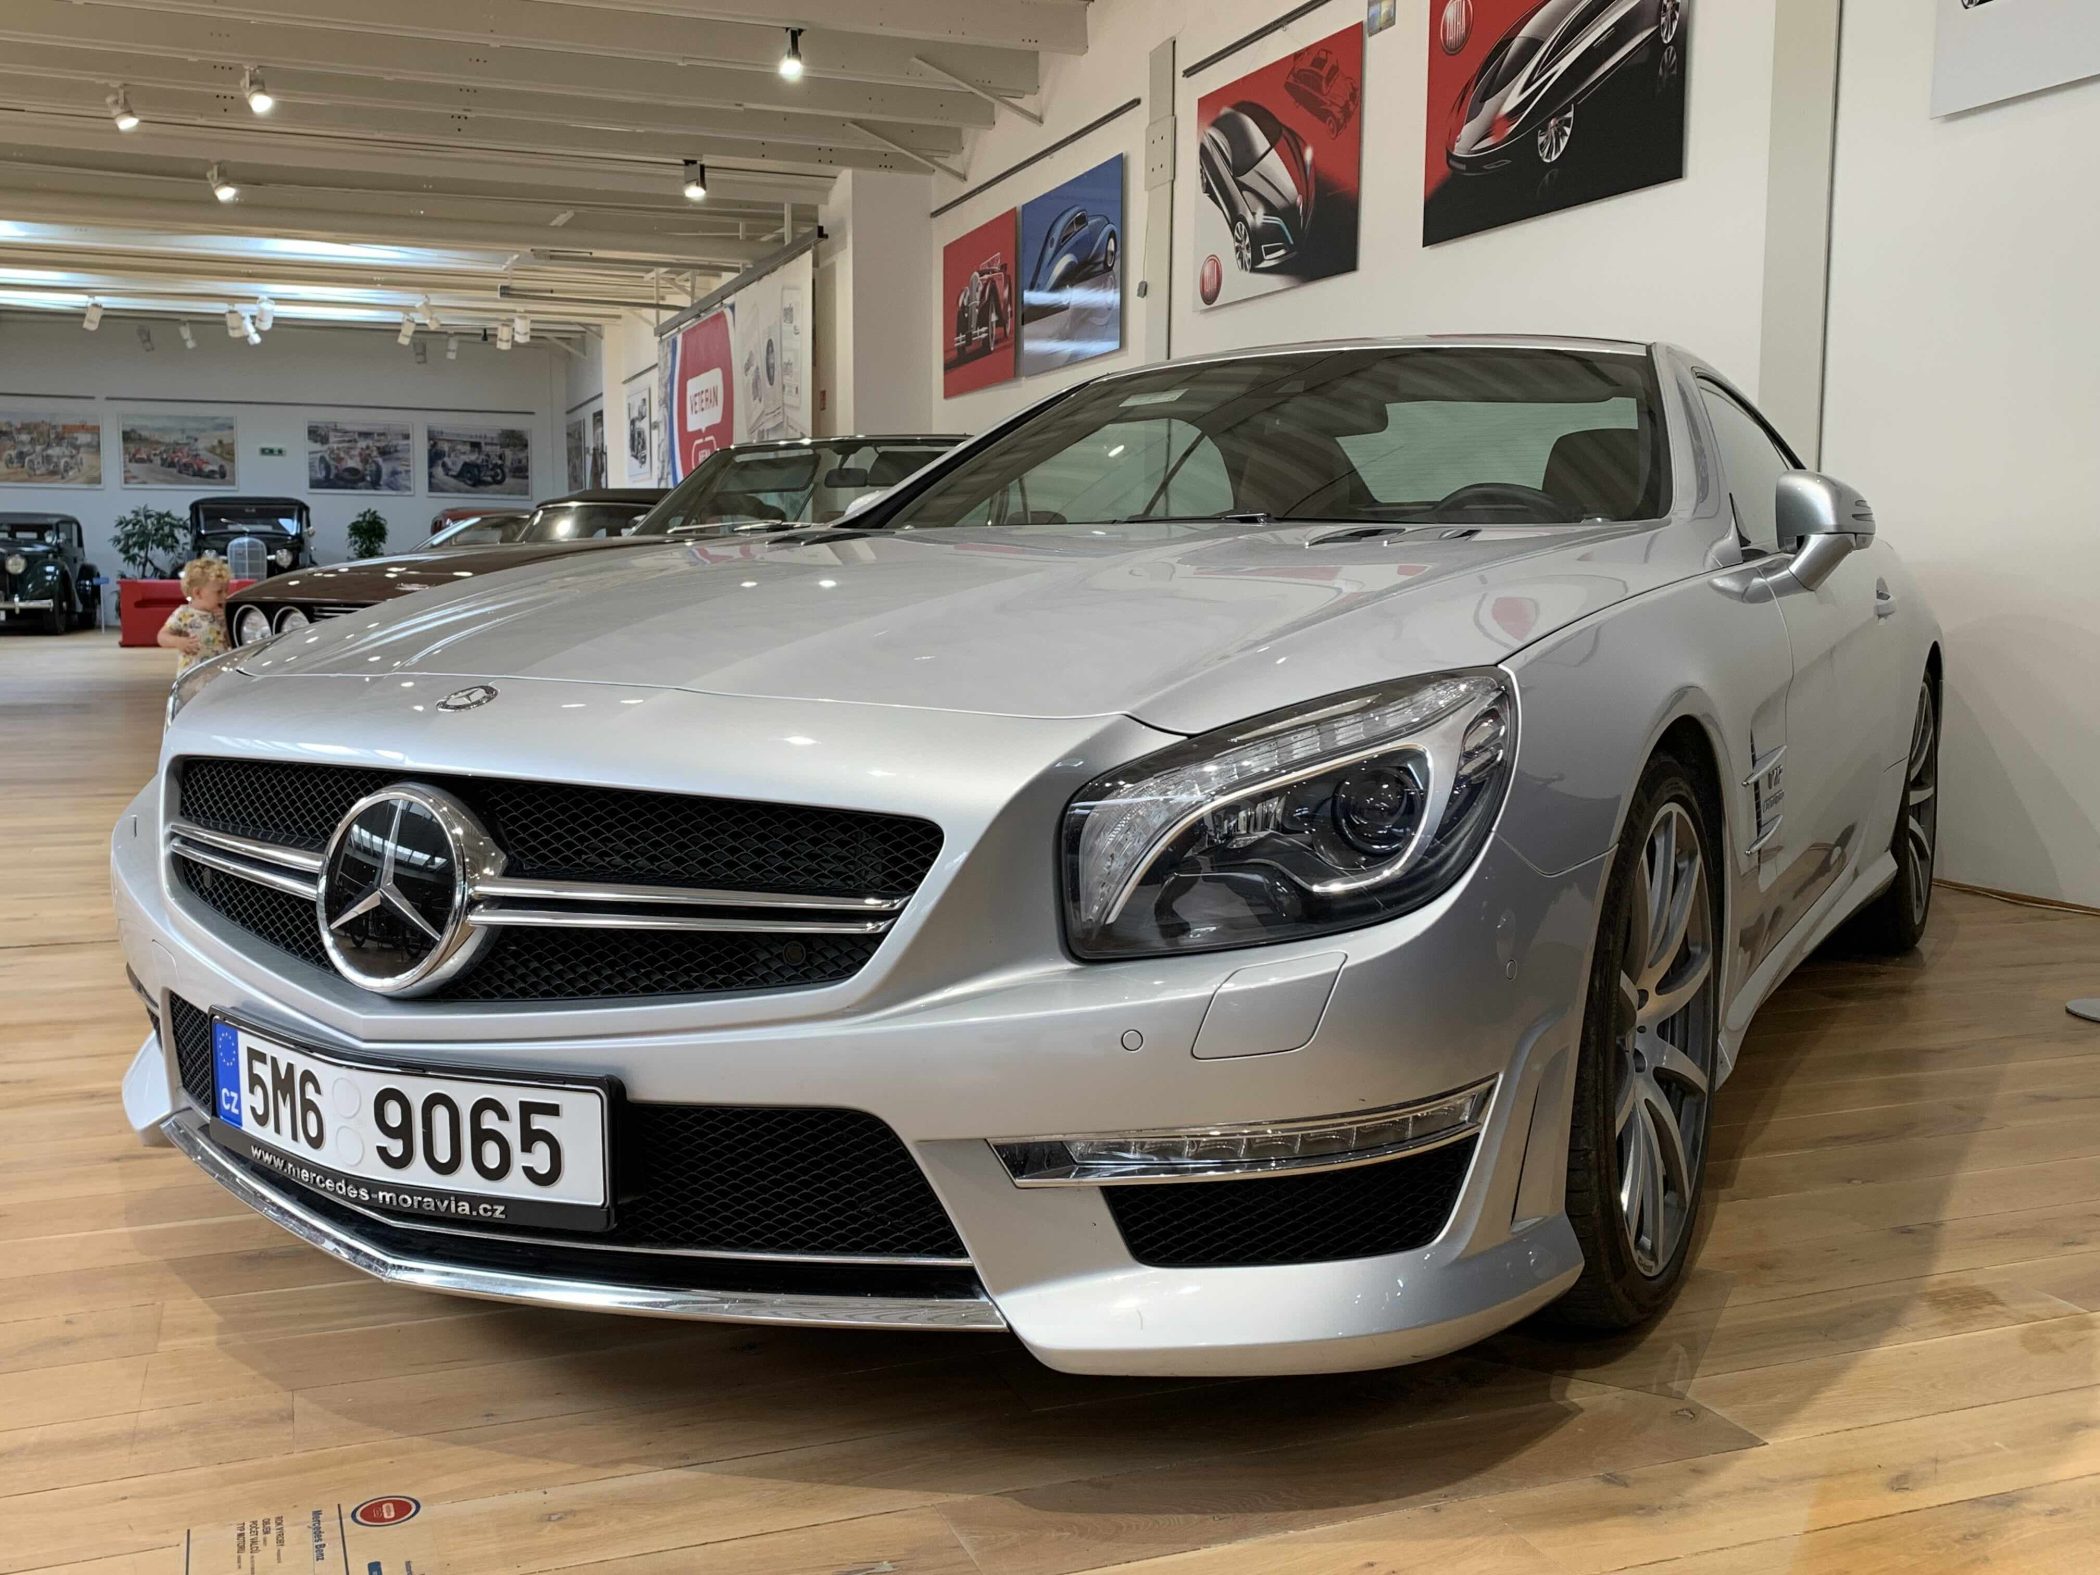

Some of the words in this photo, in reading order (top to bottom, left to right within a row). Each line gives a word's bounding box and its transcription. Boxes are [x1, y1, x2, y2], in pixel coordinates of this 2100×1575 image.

[690, 385, 719, 415] VETERAN
[221, 1088, 240, 1115] CZ
[246, 1046, 325, 1150] 5M6
[373, 1087, 563, 1187] 9065
[250, 1143, 507, 1220] www.mercedes-moravia.cz
[312, 1510, 325, 1543] Mercedes
[314, 1543, 326, 1562] Benz
